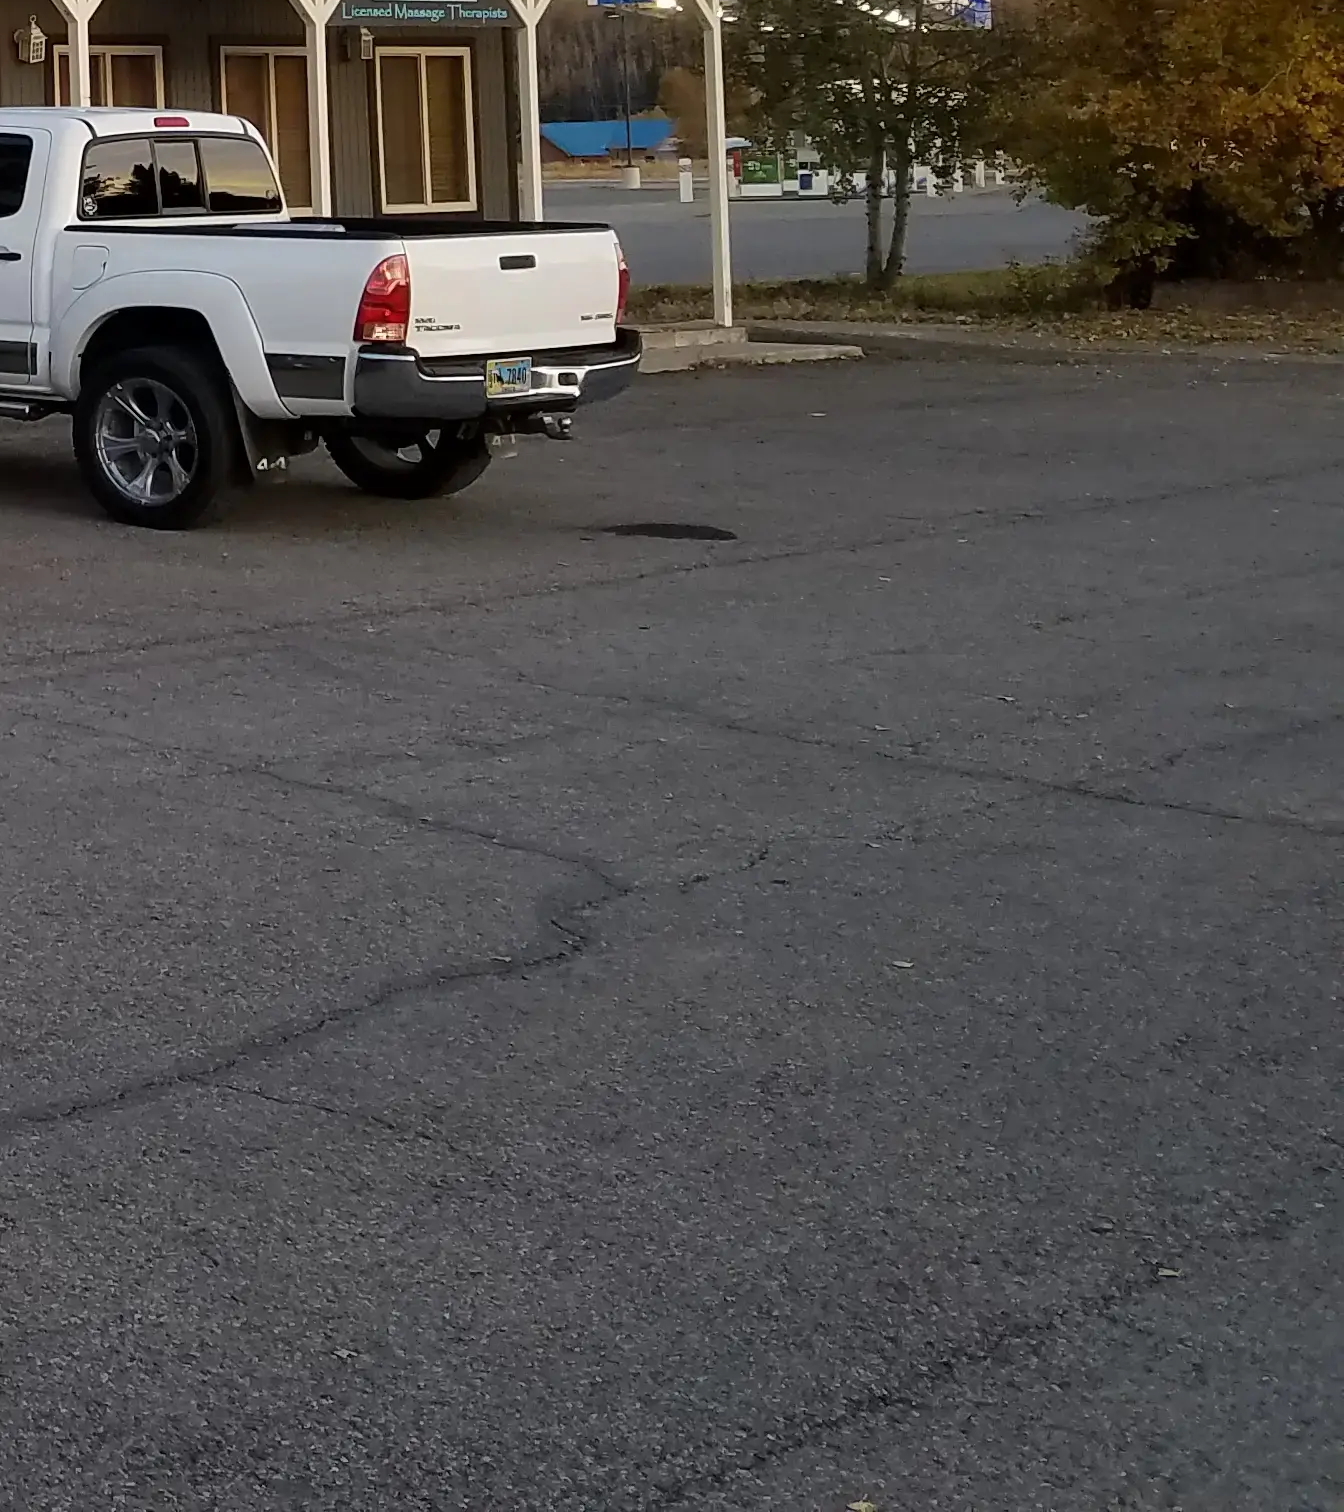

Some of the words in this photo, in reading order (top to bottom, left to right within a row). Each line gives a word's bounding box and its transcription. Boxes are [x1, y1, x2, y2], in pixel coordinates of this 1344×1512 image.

[341, 2, 393, 20] Licensed
[394, 3, 446, 23] Massage
[446, 3, 509, 24] Therapists
